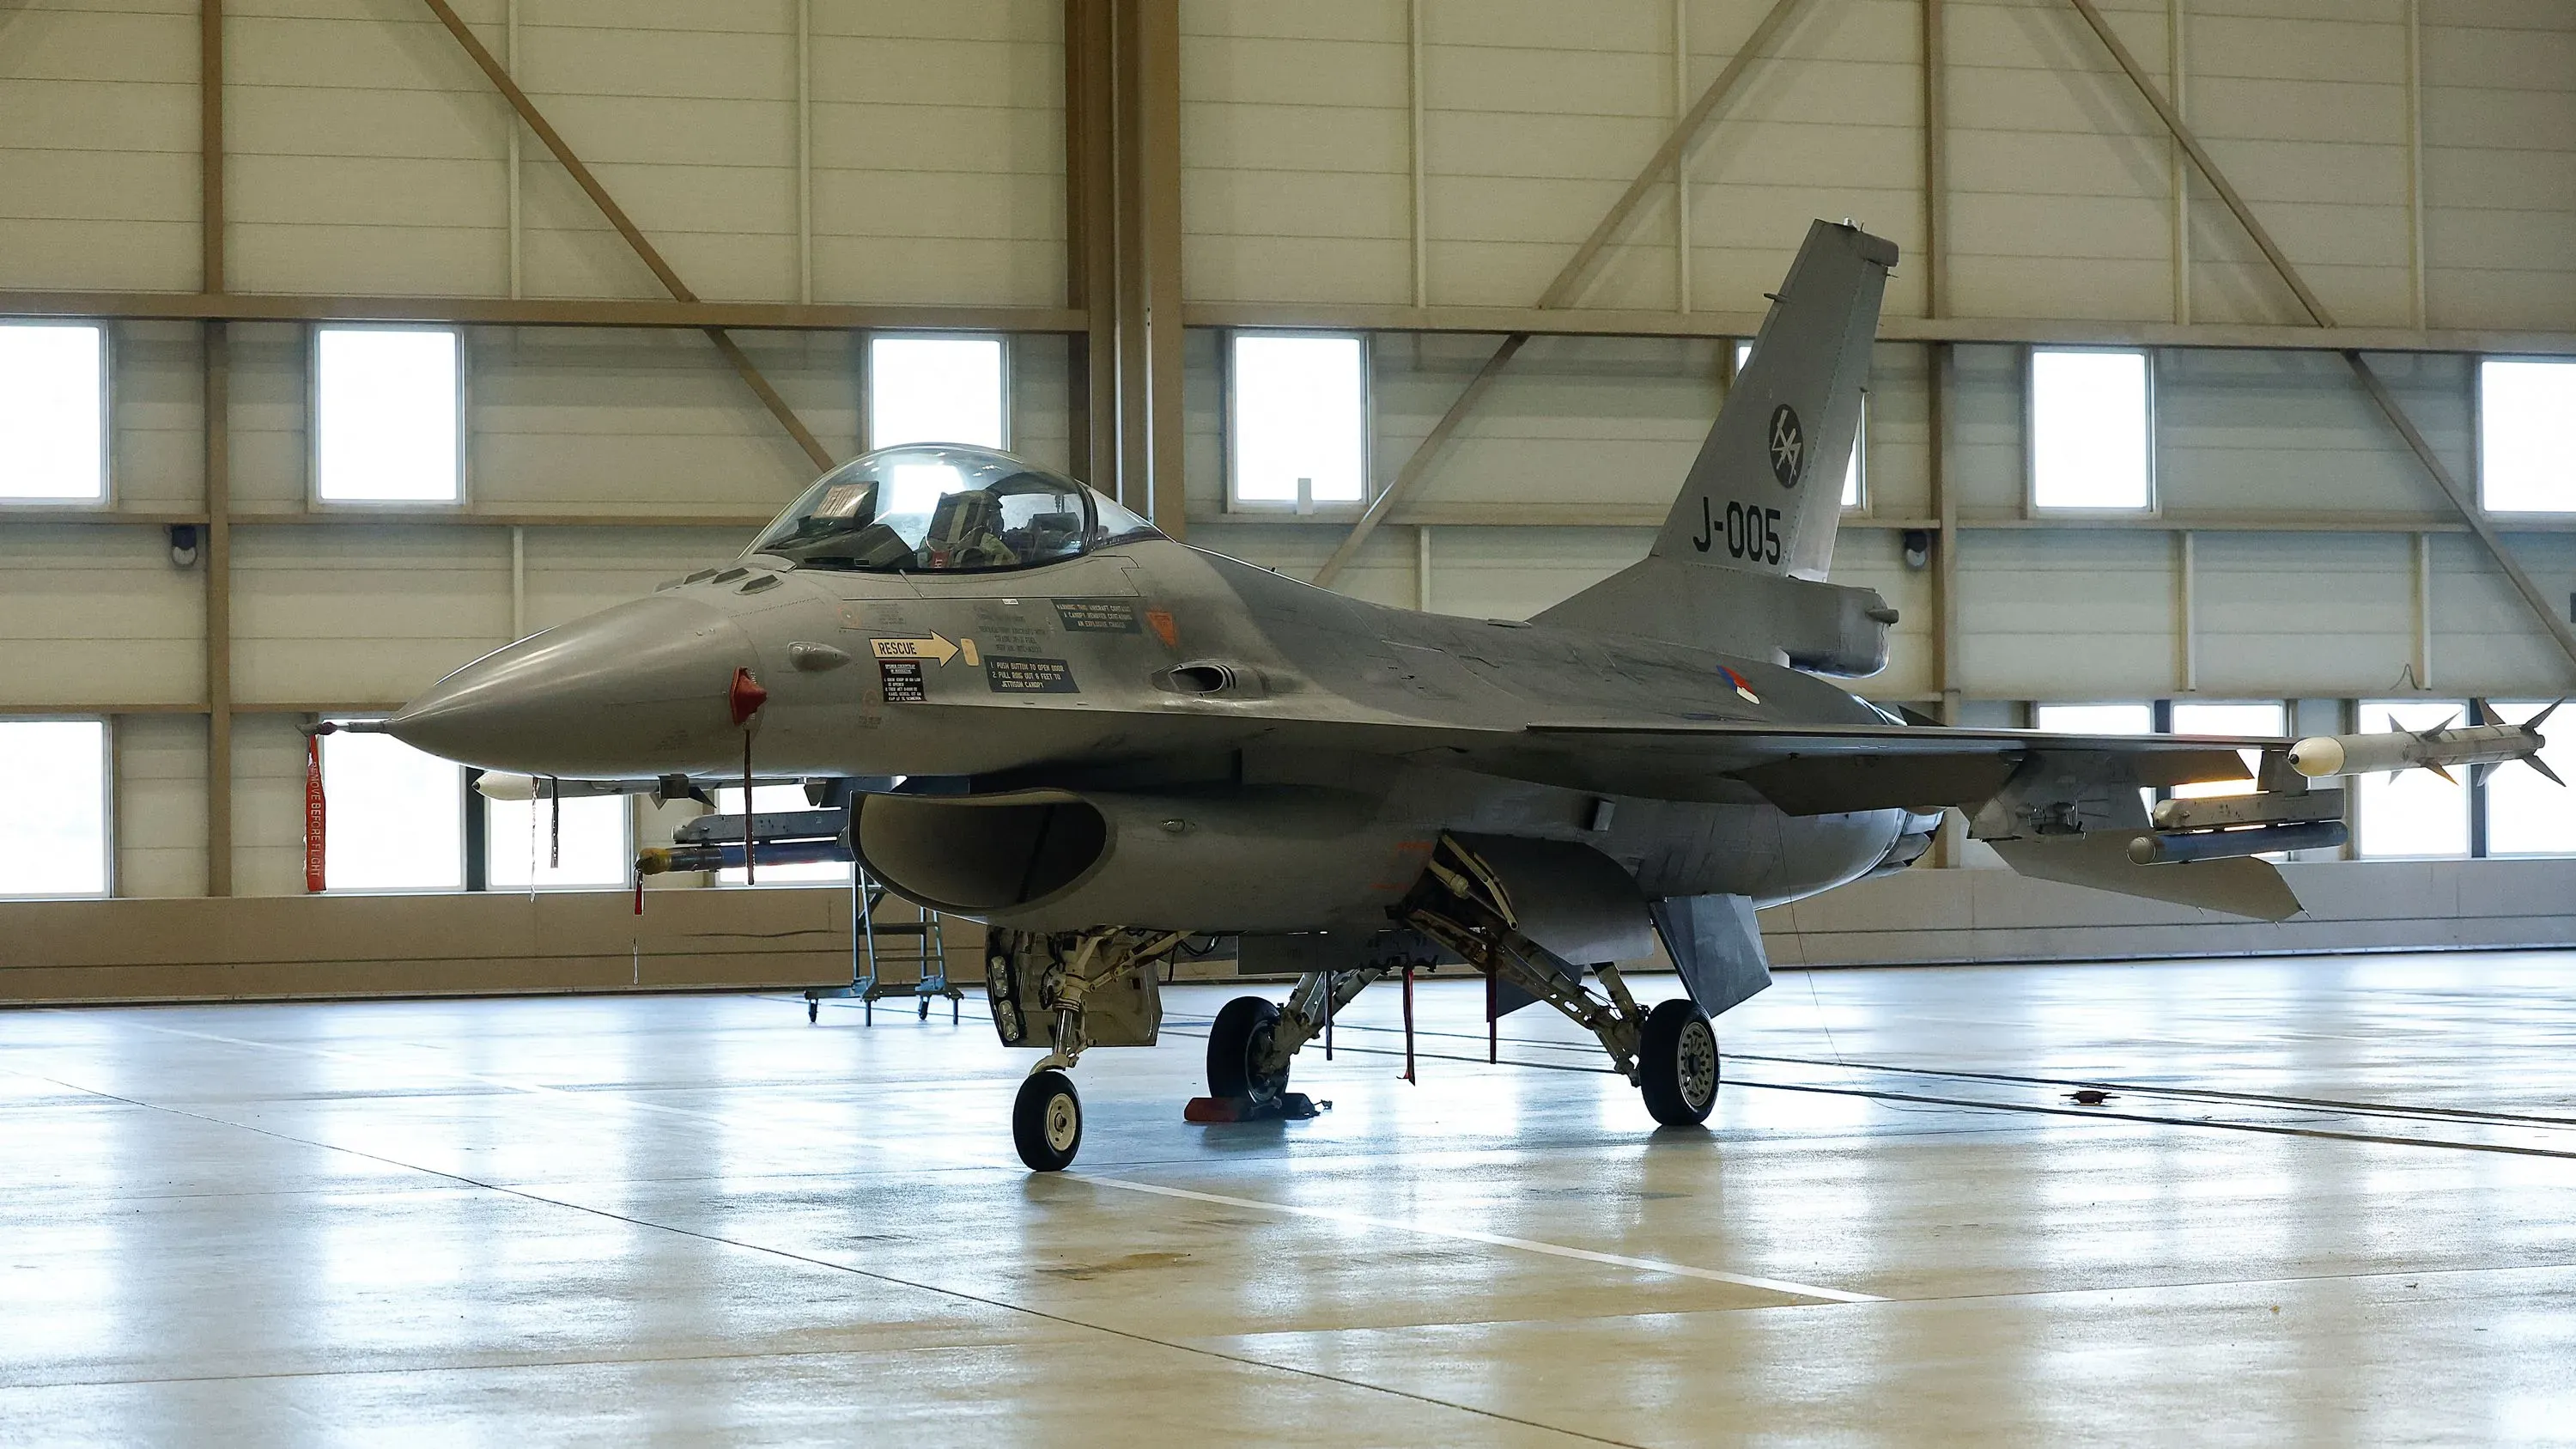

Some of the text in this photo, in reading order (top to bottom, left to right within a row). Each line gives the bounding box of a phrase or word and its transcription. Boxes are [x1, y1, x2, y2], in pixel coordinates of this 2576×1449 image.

[1693, 496, 1781, 565] J-005
[878, 642, 917, 655] RESCUE
[310, 762, 321, 877] REMOVE BEFORE FLIGHT
